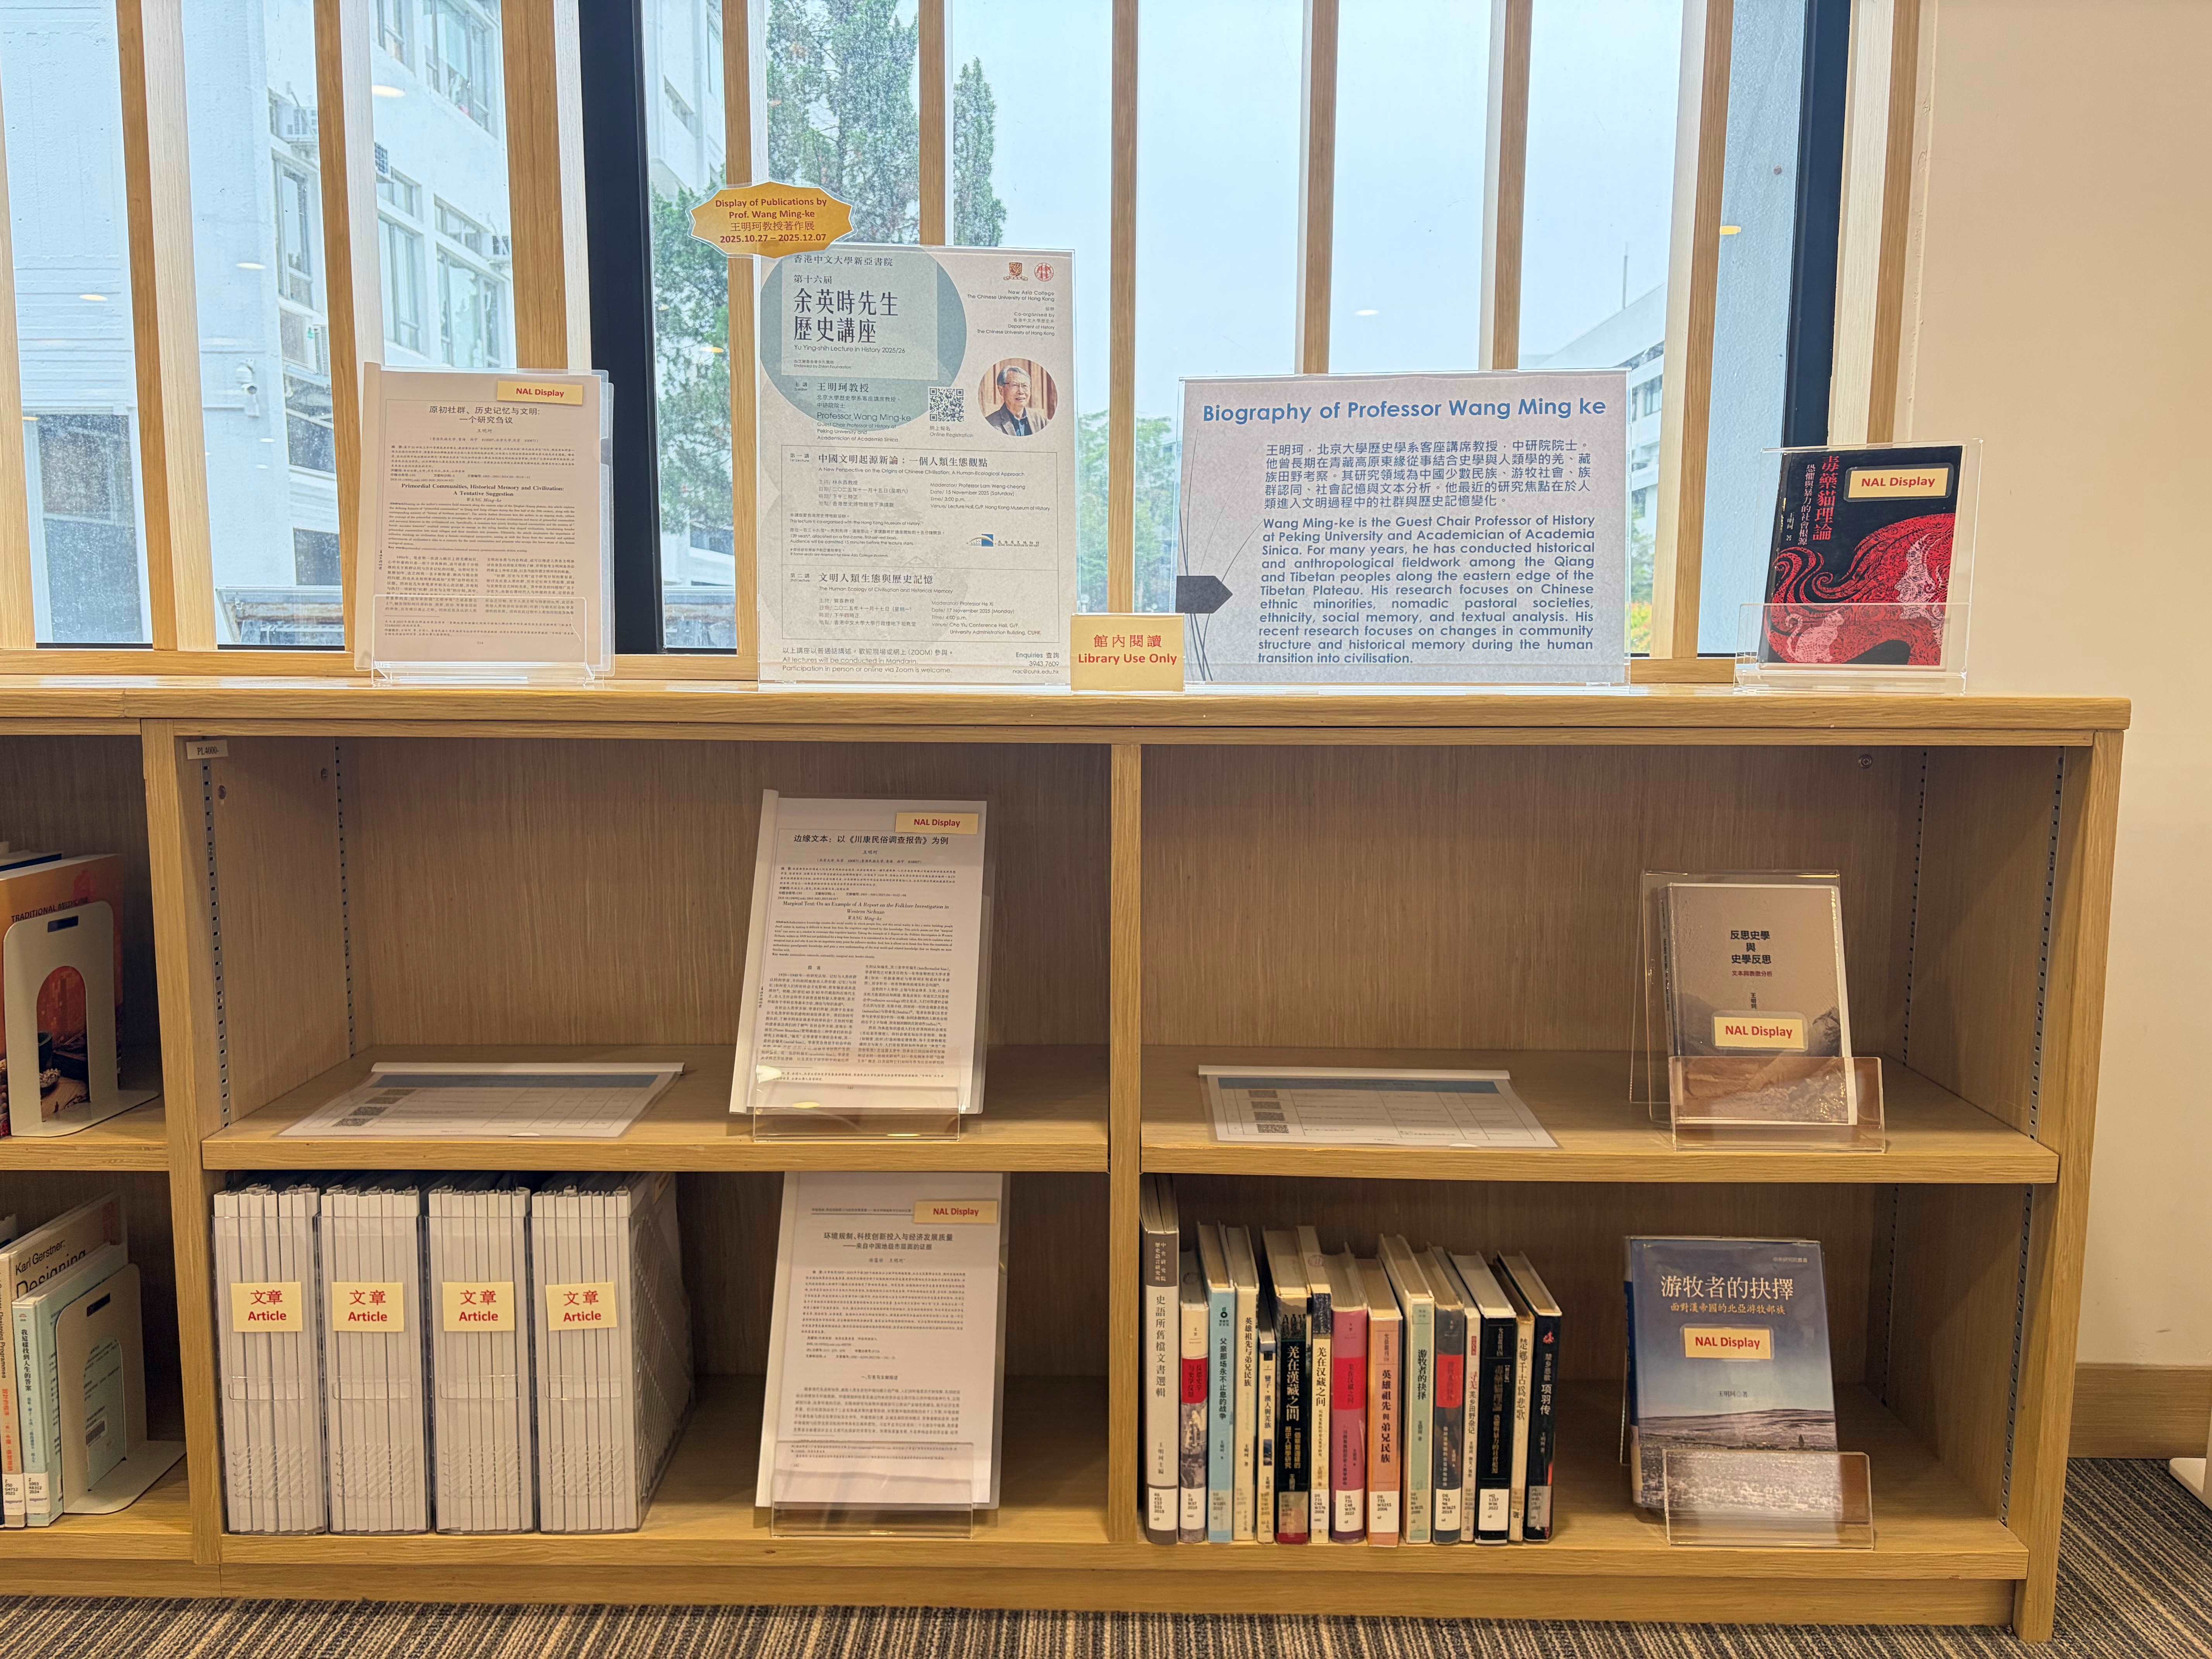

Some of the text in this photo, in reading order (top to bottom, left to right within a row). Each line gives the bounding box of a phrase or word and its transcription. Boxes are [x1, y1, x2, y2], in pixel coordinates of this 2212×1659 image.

[716, 199, 747, 208] Display
[761, 198, 814, 206] Publications
[817, 198, 827, 206] by
[751, 211, 777, 219] Wang
[780, 210, 815, 219] Ming-ke
[730, 221, 814, 232] 王明珂教授著作展
[720, 235, 768, 243] 2025.10.27
[794, 255, 893, 266] 香港中文大學新亞書院
[794, 275, 832, 284] 第十六屆
[793, 288, 898, 316] 余英時先生
[794, 316, 876, 343] 歷史講座
[535, 389, 564, 398] Display
[817, 383, 869, 393] 王明珂教授
[429, 406, 539, 415] 原初社群、历史记忆与文明:
[1204, 398, 1606, 424] Biography of Professor Wang Ming ke
[459, 416, 513, 424] 一个研究刍议
[854, 414, 878, 422] Wang
[880, 414, 911, 423] Ming-ke
[1266, 439, 1586, 456] 王明珂，北京大學歷史學系客座講席教授，中研院院士。
[1266, 453, 1590, 469] 他曾長期在青藏高原東緣從事結合史學與人類學的羌、藏
[1265, 466, 1590, 483] 族田野考察。其研究領域為中國少數民族、游牧社會、族
[1265, 480, 1590, 496] 群認同、社會記憶與文本分析。他最近的研究焦點在於人
[1862, 476, 1935, 488] NAL Display
[1264, 495, 1505, 509] 類進入文明過程中的社群與歷史記憶變化。
[1798, 464, 1815, 545] 恐懼與暴力的社會根源
[1813, 455, 1839, 540] 毒藥貓理論
[1263, 515, 1595, 530] Wang Ming-ke is the Guest Chair Professor of History
[1263, 528, 1594, 544] at Peking University and Academician of Academia
[1262, 542, 1594, 556] Sinica. For many years, he has conducted historical
[819, 573, 933, 584] 文明人類生態與歷史記憶
[1094, 634, 1162, 648] 館內閱讀
[1079, 653, 1177, 665] Library Use Only
[932, 819, 960, 828] Display
[11, 905, 58, 922] TRADITIONAL
[1730, 930, 1770, 940] 反思史學
[1746, 943, 1756, 952] 與
[1731, 954, 1771, 964] 史學反思
[1726, 1025, 1792, 1039] NAL Display
[951, 1208, 979, 1217] Display
[15, 1240, 65, 1276] Karl Gerstner:
[1661, 1275, 1793, 1300] 游牧者的抉擇
[251, 1290, 283, 1305] 文章
[248, 1310, 287, 1321] Article
[348, 1311, 387, 1321] Article
[459, 1311, 498, 1321] Article
[563, 1310, 601, 1322] Article
[1156, 1295, 1166, 1398] 史語所舊檔文書選輯
[1695, 1337, 1760, 1350] NAL Display
[1244, 1317, 1253, 1386] 英雄祖先与弟兄民族
[21, 1329, 31, 1391] 我這樣找到人生的答案
[1316, 1347, 1327, 1407] 羌在汉藏之间
[1418, 1349, 1427, 1400] 游牧者的抉择
[1286, 1345, 1300, 1421] 羌在漢藏之間
[1540, 1384, 1552, 1415] 项羽传
